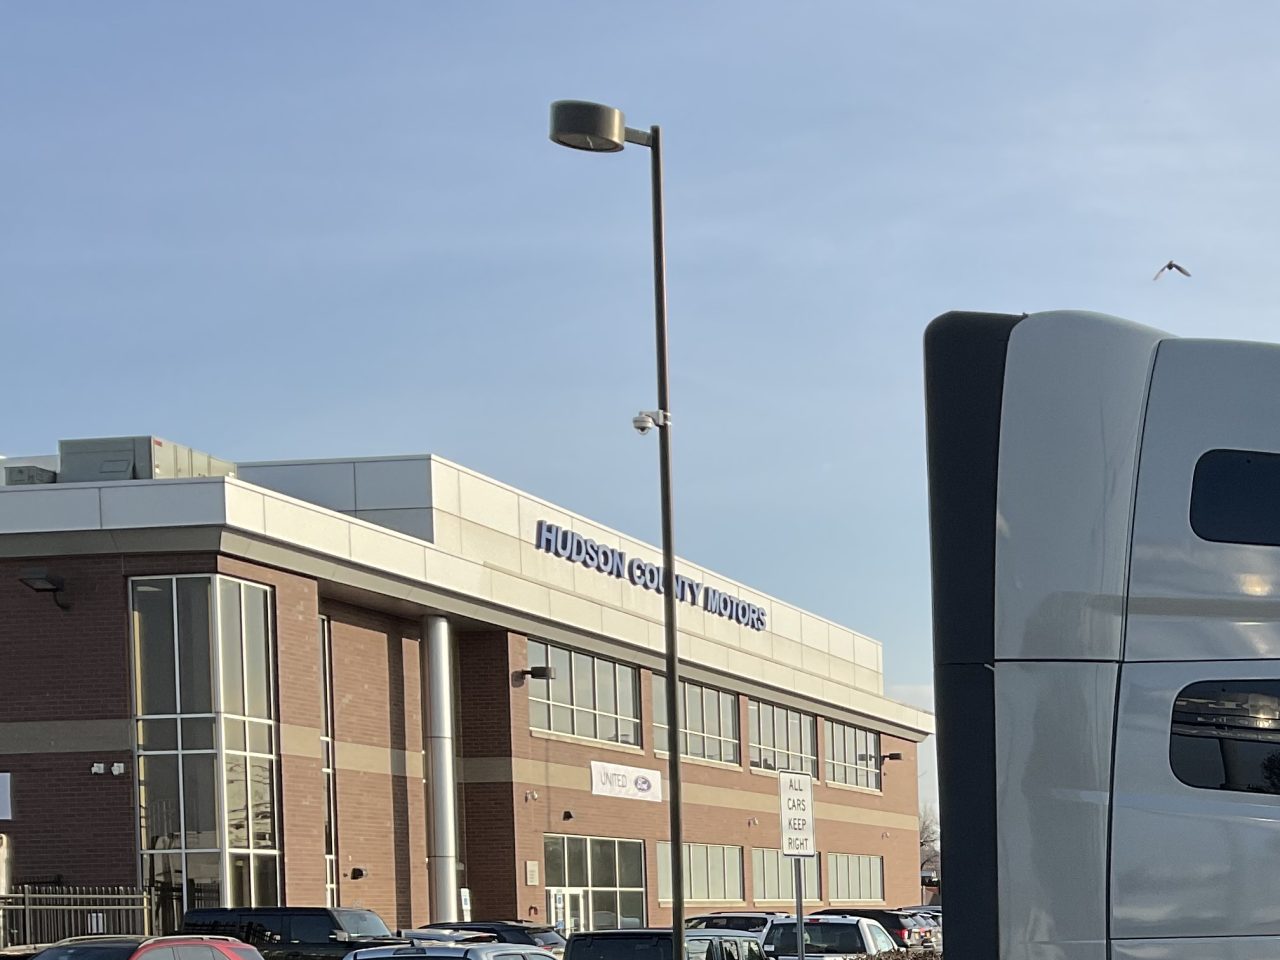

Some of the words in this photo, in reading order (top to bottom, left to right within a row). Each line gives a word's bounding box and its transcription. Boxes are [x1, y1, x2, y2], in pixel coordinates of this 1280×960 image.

[535, 520, 626, 578] HUDSON
[703, 585, 767, 631] MOTORS
[600, 769, 627, 788] UNITED
[788, 778, 803, 791] ALL
[787, 798, 806, 811] CARS
[788, 818, 807, 831] KEEP
[788, 837, 808, 850] RIGHT
